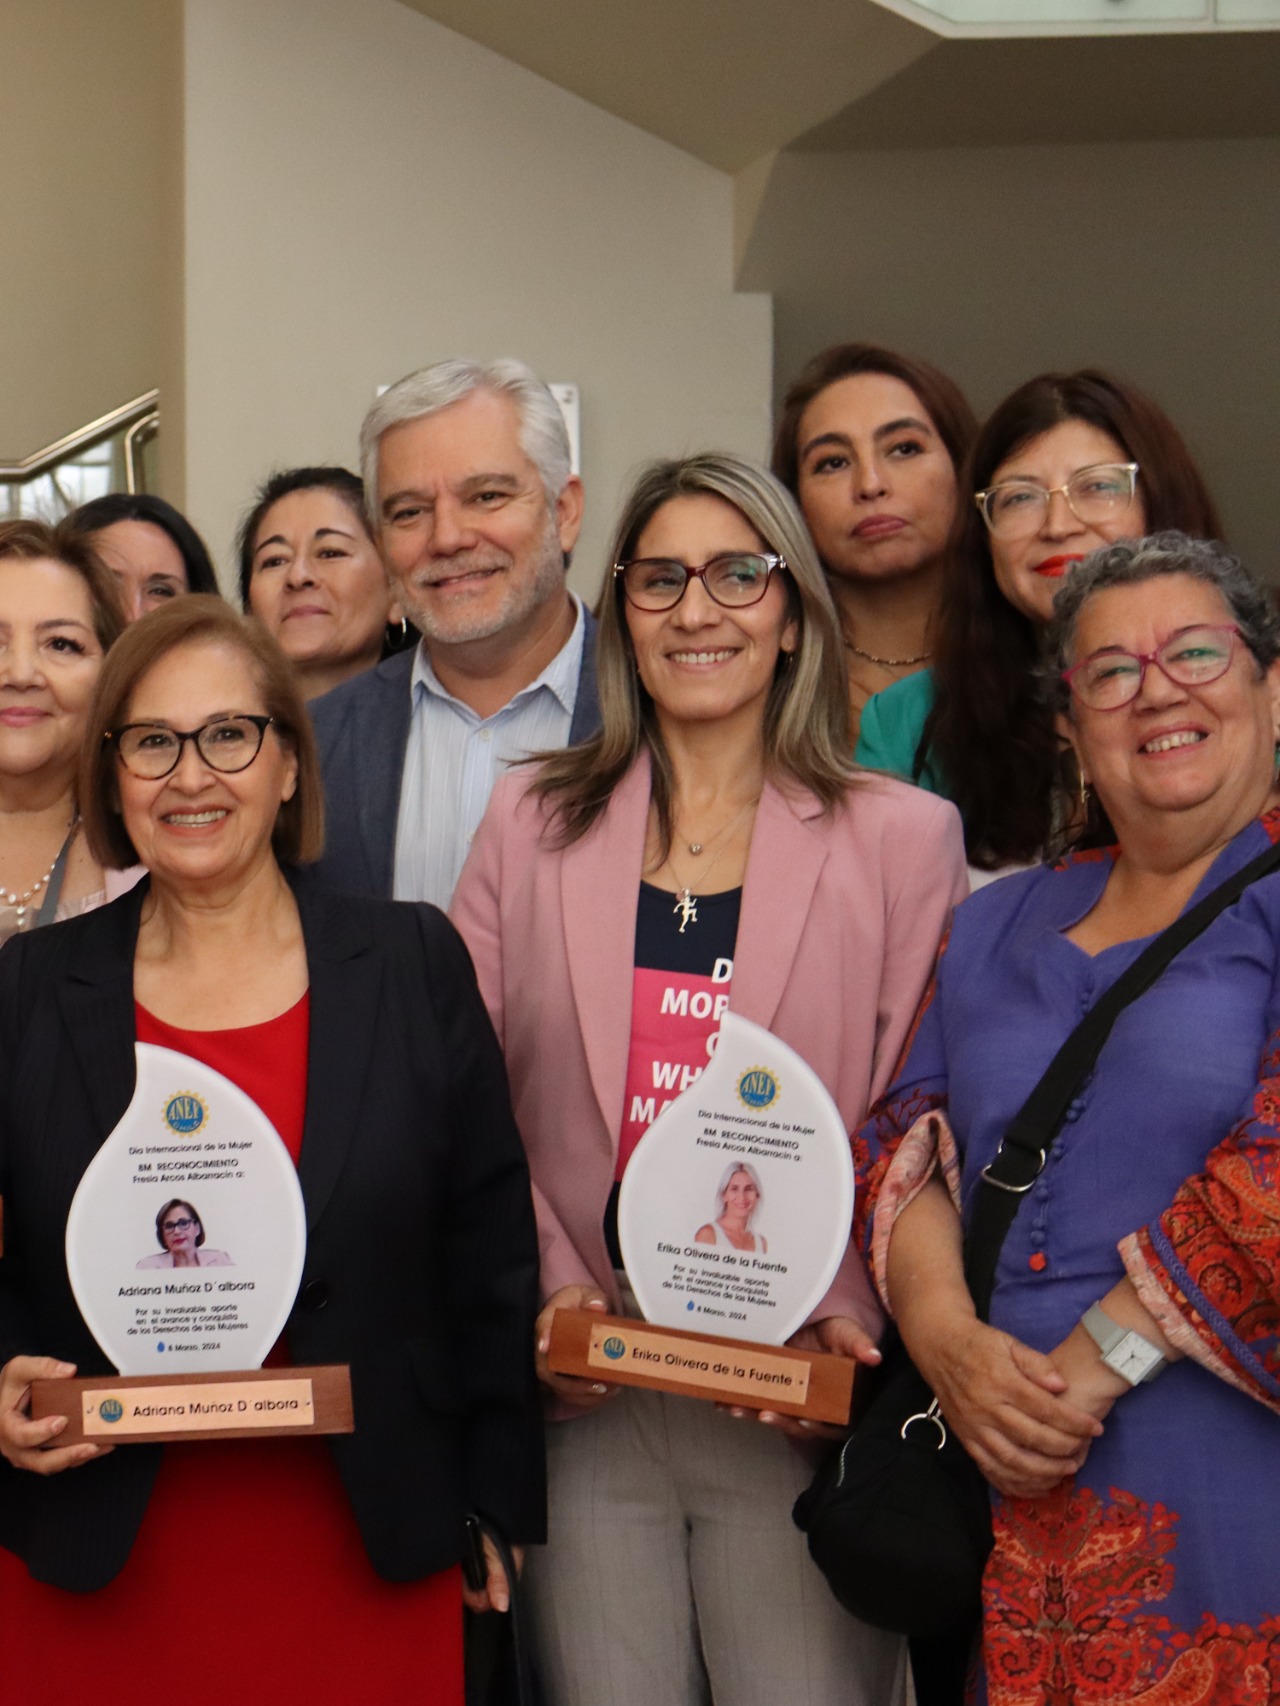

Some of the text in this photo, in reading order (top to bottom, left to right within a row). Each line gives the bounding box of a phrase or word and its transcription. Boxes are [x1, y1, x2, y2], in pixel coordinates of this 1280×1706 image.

[652, 1061, 703, 1092] WH
[713, 1112, 768, 1128] Internacional
[769, 1121, 781, 1130] de
[782, 1123, 790, 1131] la
[792, 1125, 816, 1136] Mujer
[145, 1144, 202, 1154] Internacional
[204, 1143, 215, 1151] de
[218, 1142, 226, 1150] la
[228, 1141, 253, 1151] Mujer
[696, 1138, 720, 1148] Fresia
[722, 1142, 745, 1153] Arcos
[721, 1130, 799, 1150] RECONOCIMIENTO
[157, 1159, 239, 1171] RECONOCIMIENTO
[132, 1175, 158, 1184] Fresia
[160, 1174, 185, 1182] Arcos
[657, 1242, 788, 1274] Erika Olivera de la Fuente
[118, 1286, 162, 1297] Adriana
[165, 1283, 201, 1295] Muñoz
[662, 1280, 673, 1289] de
[686, 1284, 721, 1297] Derechos
[723, 1291, 733, 1299] de
[747, 1295, 777, 1307] Mujeres
[728, 1311, 747, 1321] 2024
[127, 1327, 138, 1335] de
[153, 1325, 190, 1334] Derechos
[218, 1322, 249, 1332] Mujeres
[202, 1342, 221, 1350] 2024
[632, 1347, 661, 1363] Erika
[665, 1353, 709, 1371] Olivera
[713, 1362, 730, 1375] de
[733, 1365, 745, 1378] la
[749, 1368, 793, 1386] Fuente
[133, 1405, 185, 1417] Adriana
[189, 1402, 234, 1415] Muñoz
